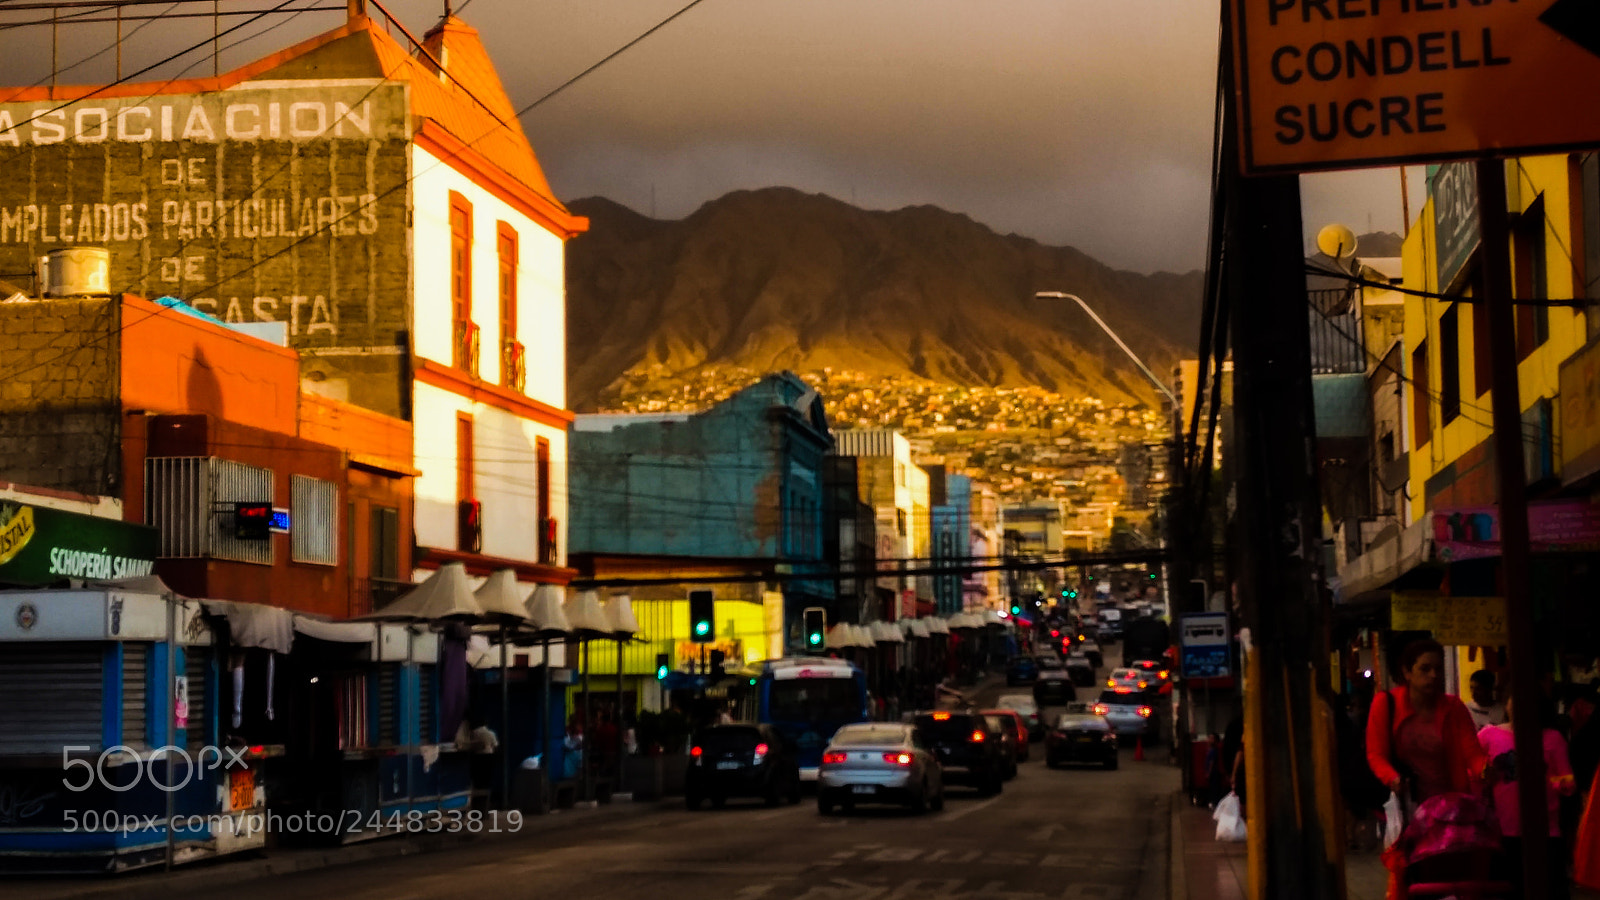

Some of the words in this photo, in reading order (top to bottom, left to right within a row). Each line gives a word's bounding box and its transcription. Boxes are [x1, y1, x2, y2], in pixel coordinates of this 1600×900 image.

[1270, 27, 1512, 86] CONDELL
[0, 101, 372, 147] ASOCIACION
[1274, 92, 1447, 146] SUCRE
[160, 157, 207, 186] DE
[161, 194, 379, 240] PARTICULARES
[160, 256, 206, 283] DE
[50, 547, 113, 580] SCHOPERÍA
